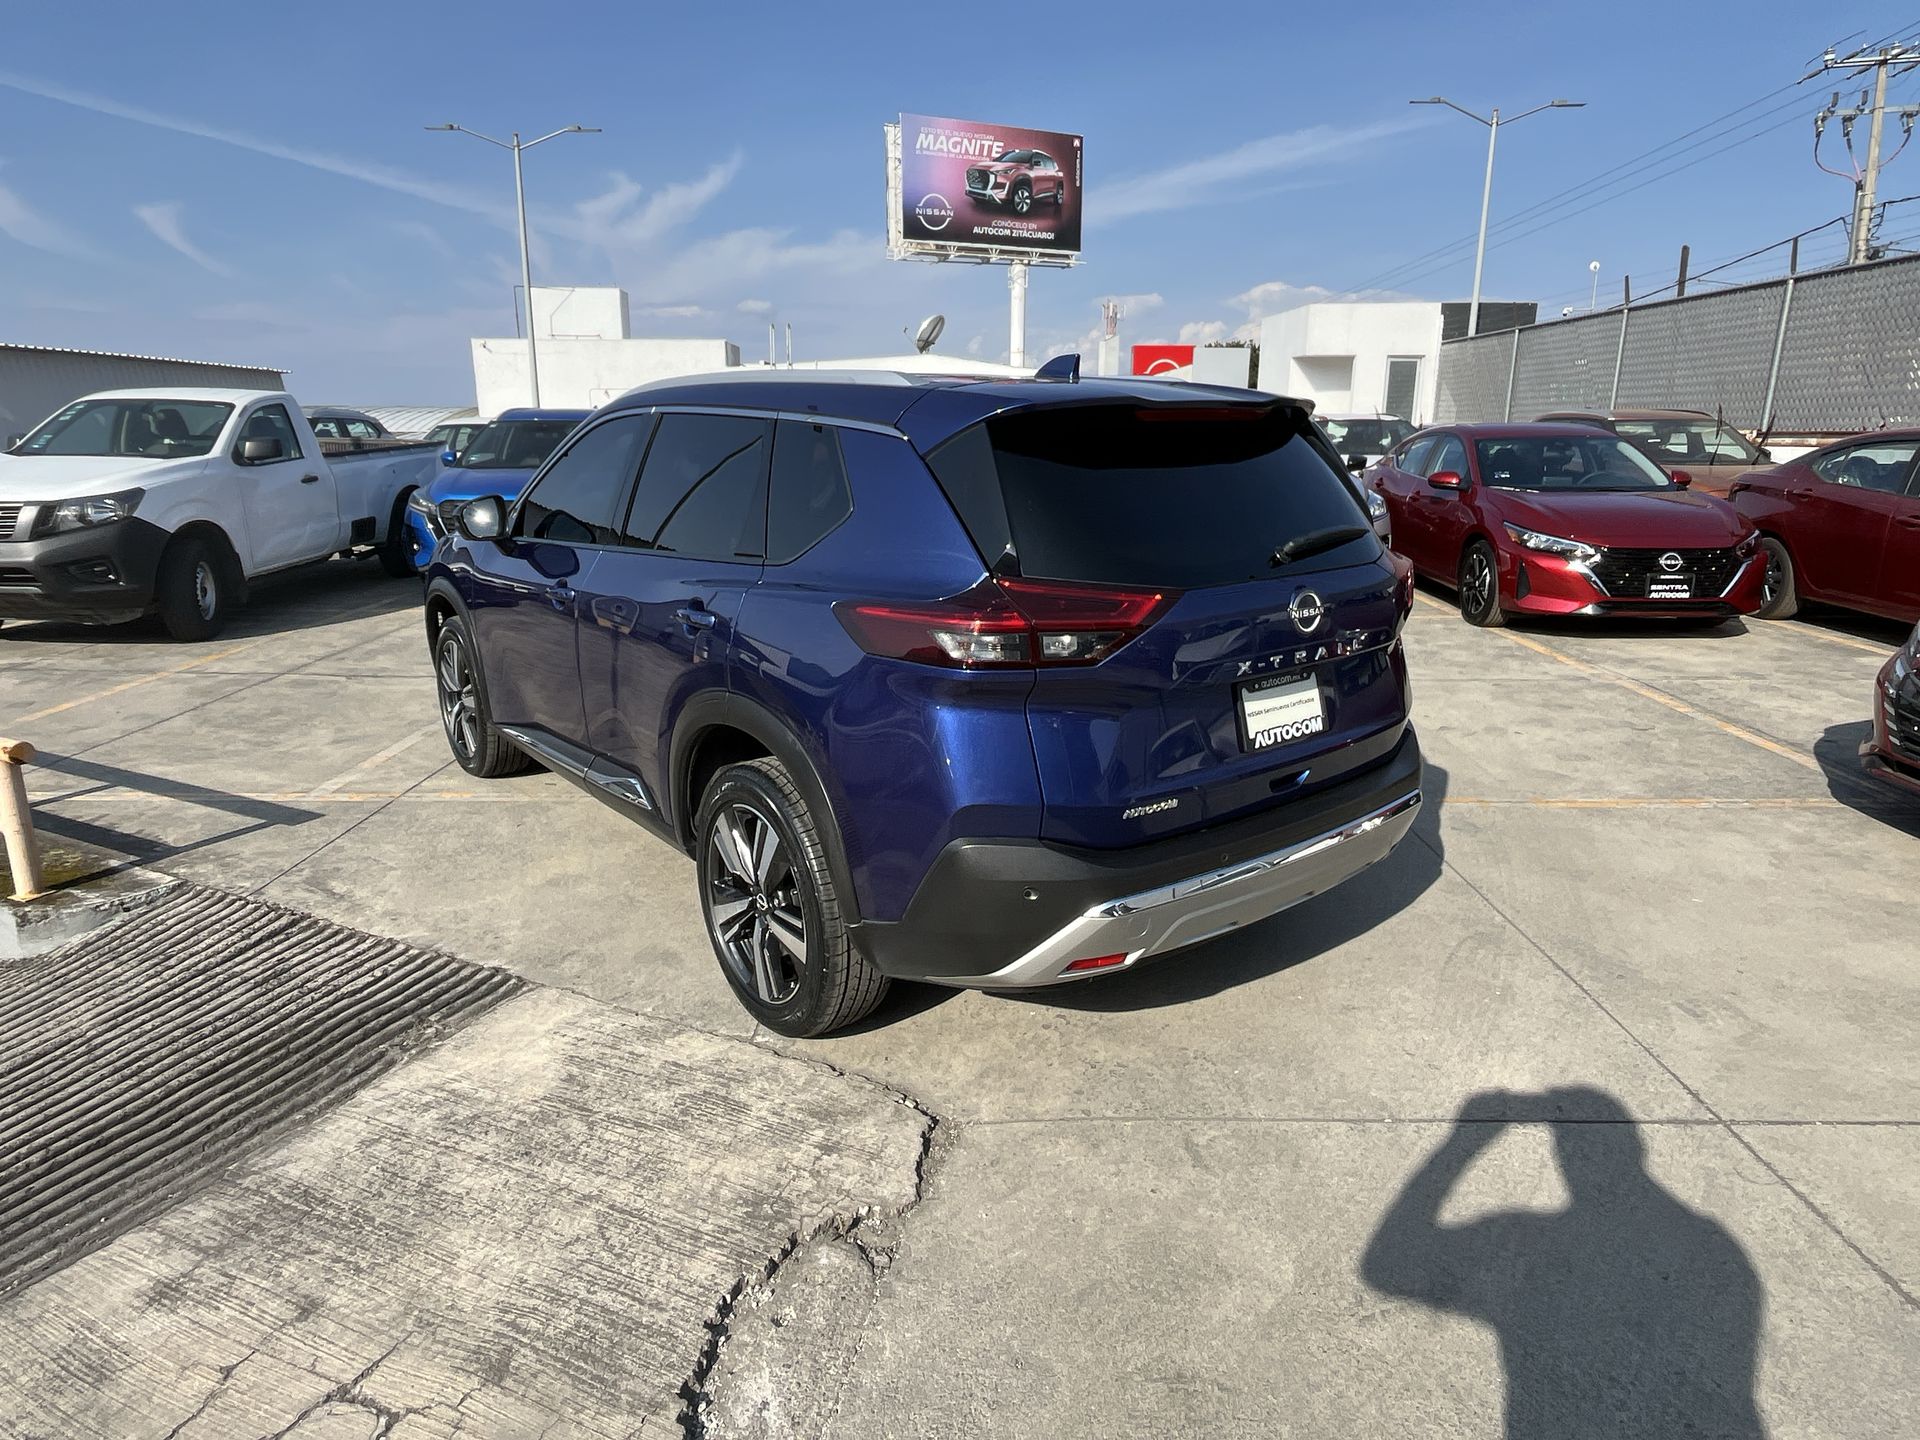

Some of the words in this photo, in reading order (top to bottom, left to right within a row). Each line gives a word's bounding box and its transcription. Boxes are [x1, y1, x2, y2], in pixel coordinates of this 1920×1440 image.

[916, 133, 1004, 158] MAGNITE
[916, 207, 954, 216] NISSAN
[973, 226, 1011, 236] AUTOCOM
[1028, 221, 1038, 230] EN
[1291, 606, 1324, 620] NISSAN
[1236, 637, 1363, 677] X-TRAIL
[1254, 716, 1324, 748] AUTOCOM
[1122, 799, 1178, 820] AUTOCOM
